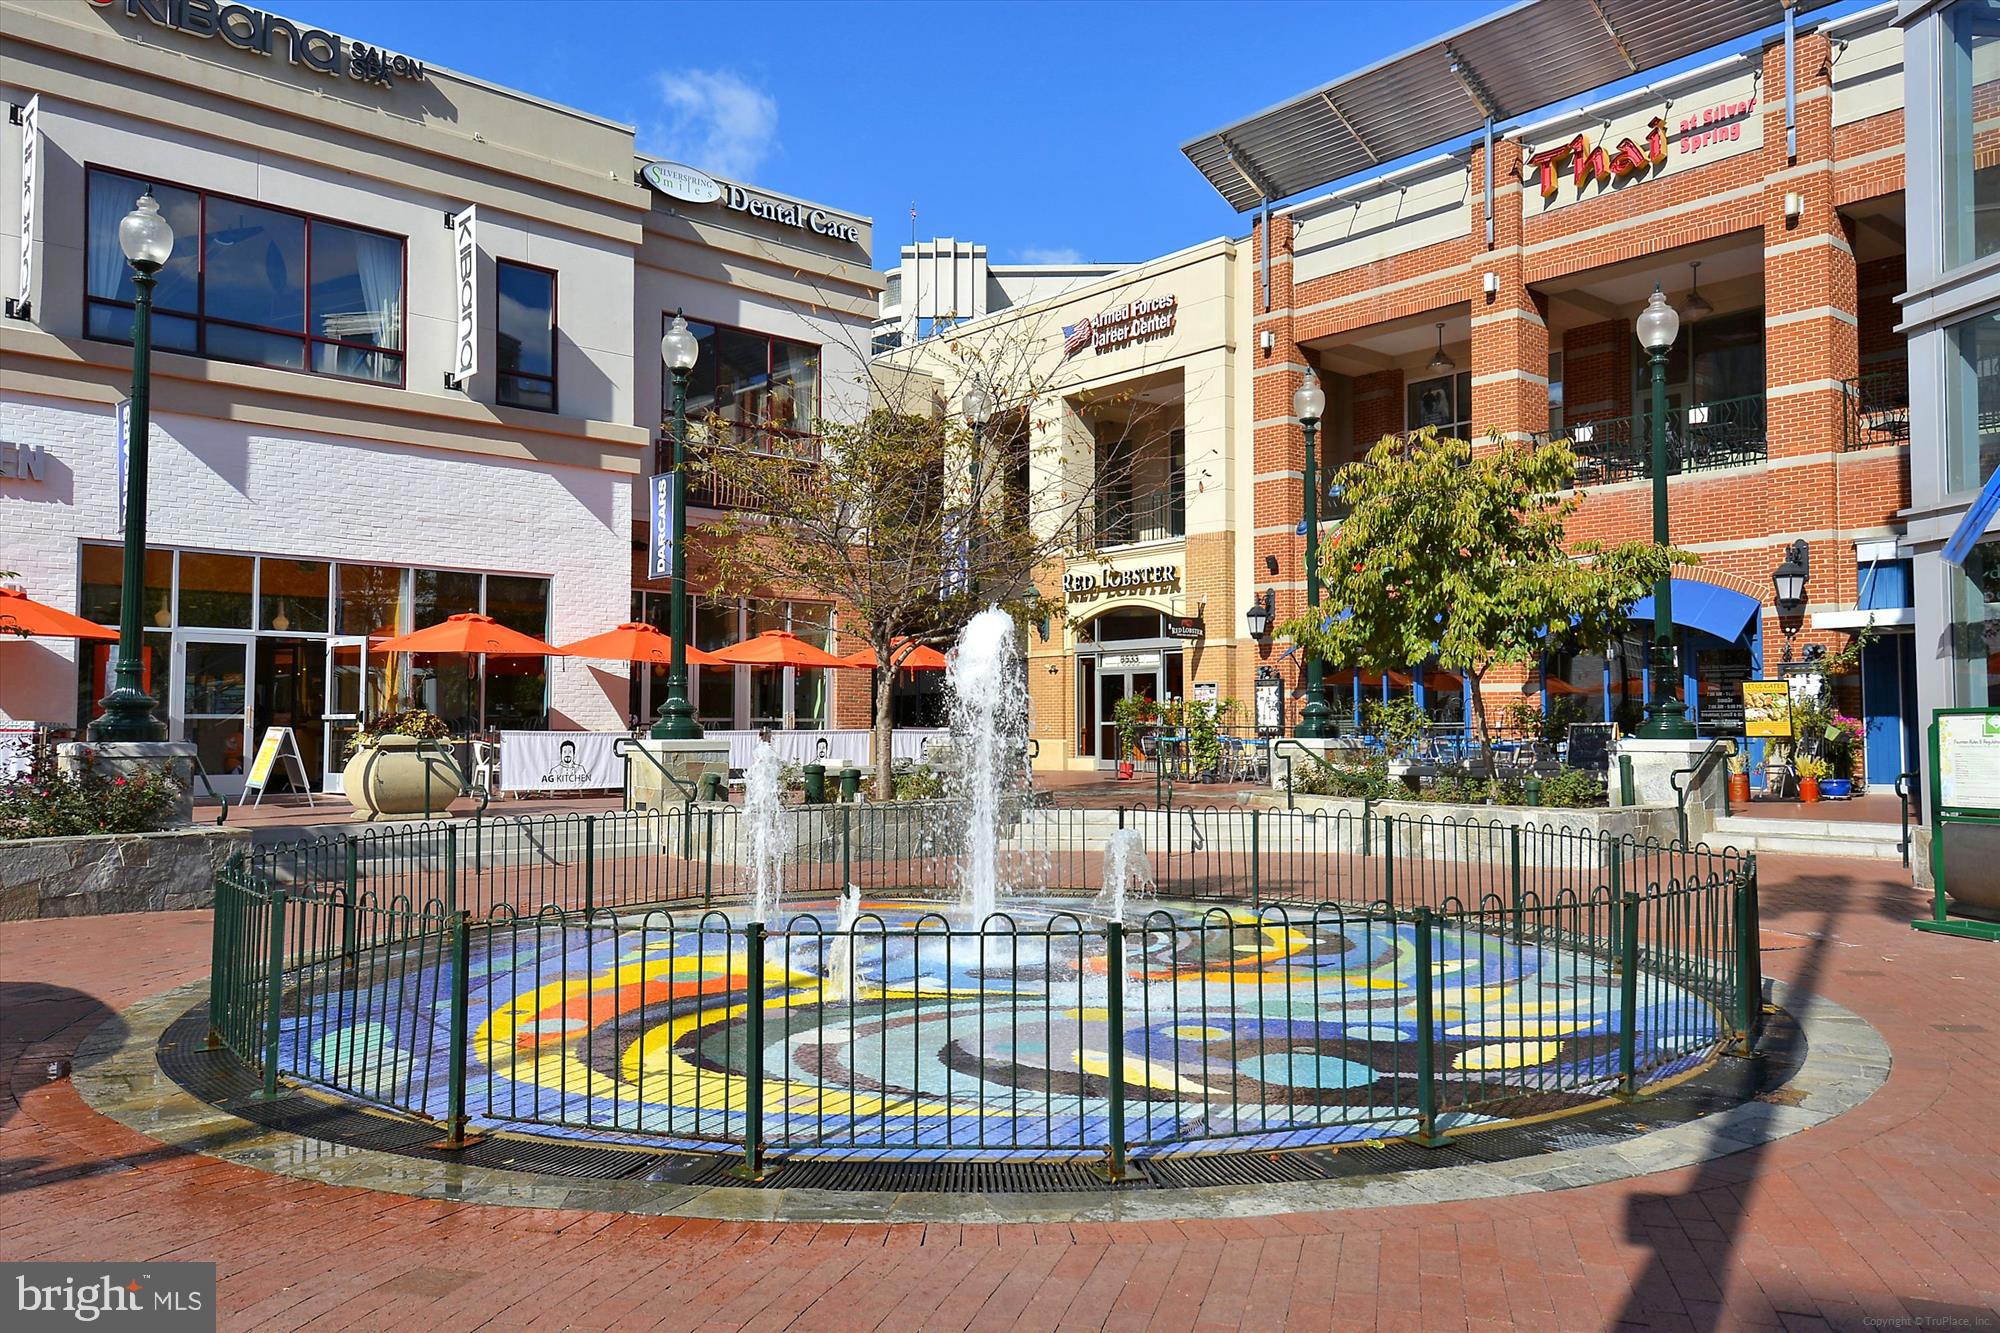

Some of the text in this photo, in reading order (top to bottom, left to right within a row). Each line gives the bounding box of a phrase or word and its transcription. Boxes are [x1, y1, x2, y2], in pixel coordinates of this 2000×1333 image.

[347, 59, 393, 89] SPA
[349, 40, 425, 81] SALON
[1679, 99, 1757, 133] at Silver
[1679, 122, 1741, 155] Spring
[1529, 117, 1669, 197] Thai
[725, 184, 859, 243] Dental Care
[1091, 294, 1176, 328] Armed Forces
[1092, 313, 1174, 348] Career Center
[657, 479, 667, 573] DARCARS
[1061, 565, 1176, 593] RED LOBSTER
[1171, 627, 1183, 635] RED
[541, 774, 591, 783] AG KITCHEN
